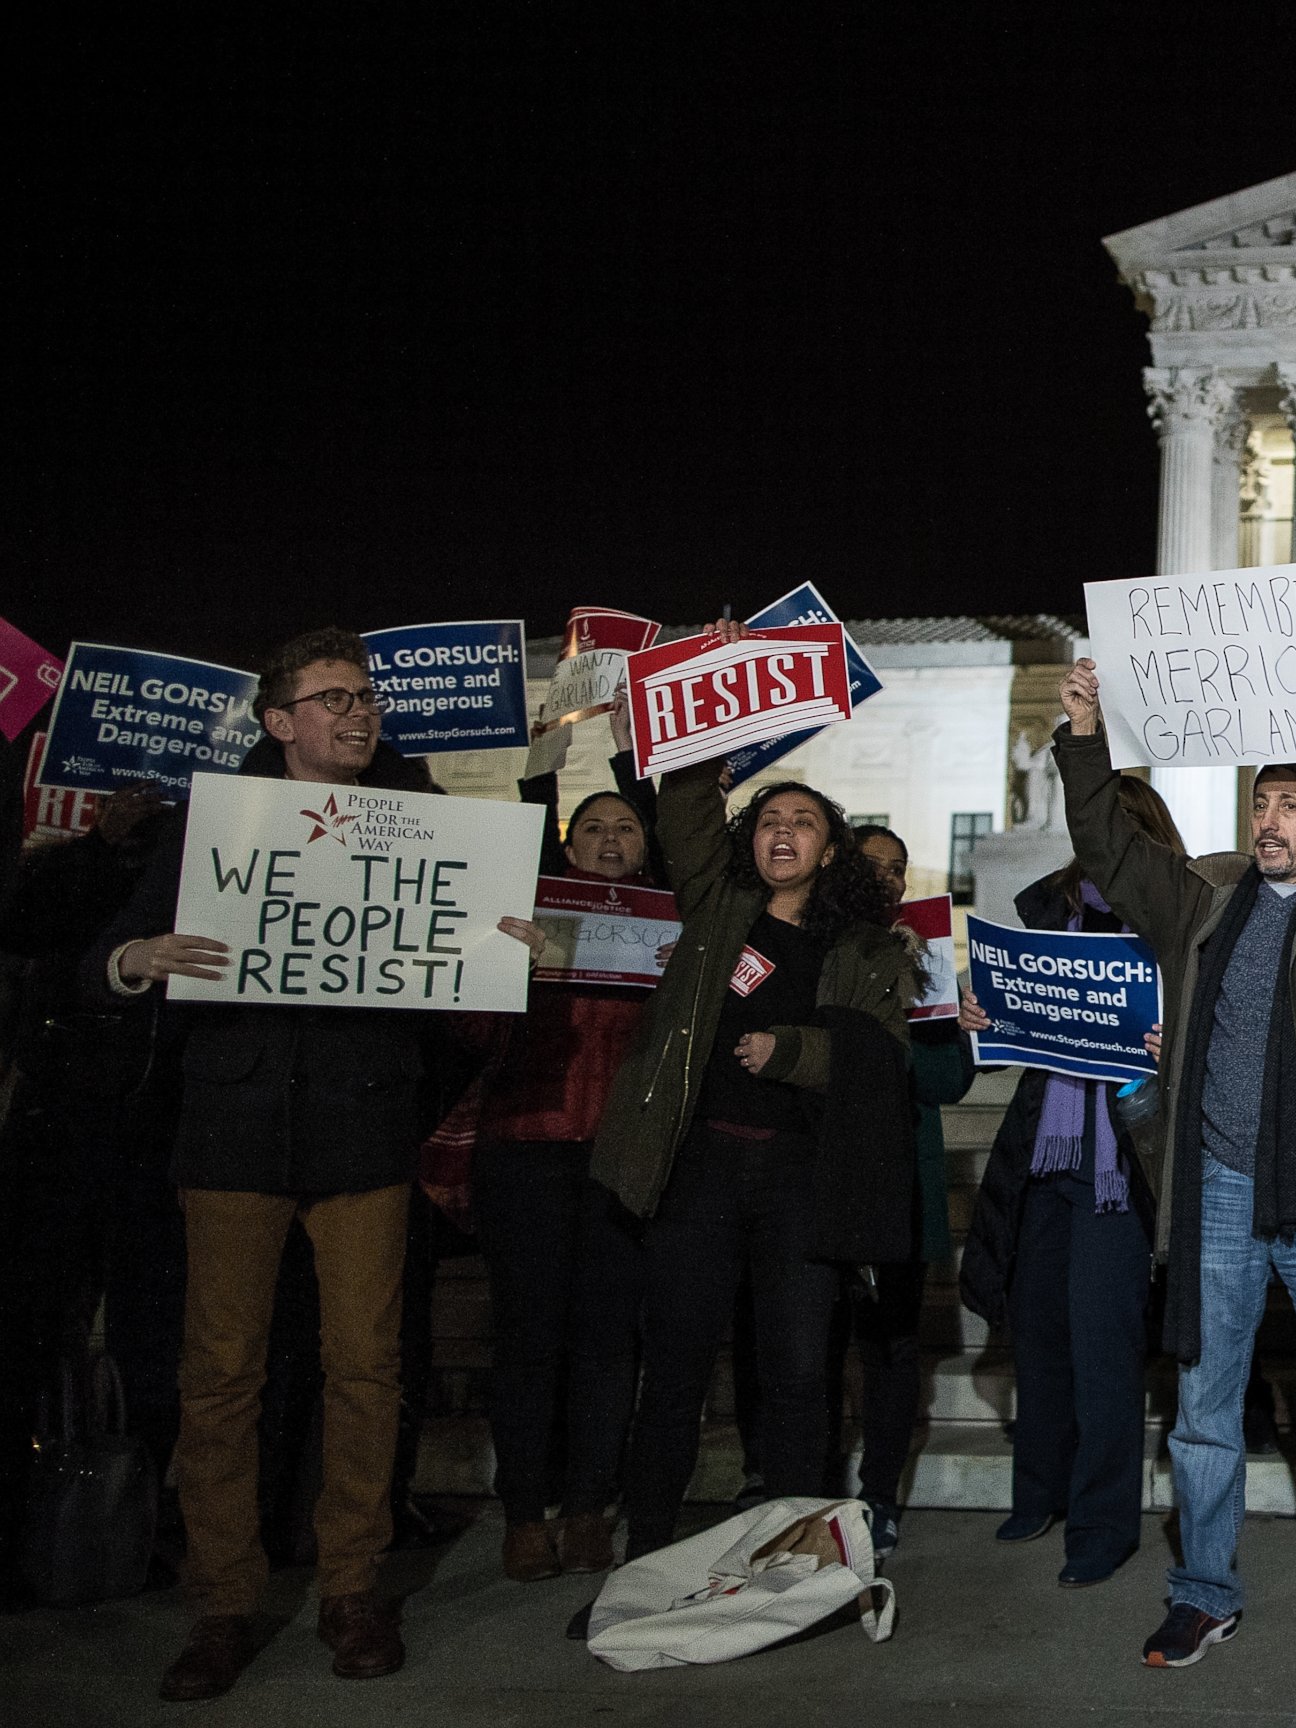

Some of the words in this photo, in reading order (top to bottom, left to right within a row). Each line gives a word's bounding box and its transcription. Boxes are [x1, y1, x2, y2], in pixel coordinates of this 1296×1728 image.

[394, 644, 519, 668] GORSUCH:
[70, 669, 134, 696] NEIL
[464, 668, 500, 688] and
[645, 651, 830, 744] RESIST
[91, 698, 204, 735] Extreme
[211, 724, 262, 748] and
[398, 725, 516, 742] www.StopGorsuch.com
[97, 722, 241, 769] Dangerous
[347, 793, 405, 812] PEOPLE
[350, 821, 435, 840] AMERICAN
[366, 810, 398, 826] FOR
[400, 816, 421, 826] THE
[358, 837, 394, 852] WAY
[211, 847, 301, 897] WE
[351, 854, 468, 905] THE
[258, 899, 468, 955] PEOPLE
[237, 948, 465, 1003] RESIST!
[971, 938, 1017, 971] NEIL
[1018, 952, 1153, 983] GORSUCH:
[991, 970, 1080, 1001] Extreme
[1086, 987, 1127, 1008] and
[1005, 993, 1120, 1027] Dangerous
[1030, 1030, 1148, 1056] www.StopGorsuch.com
